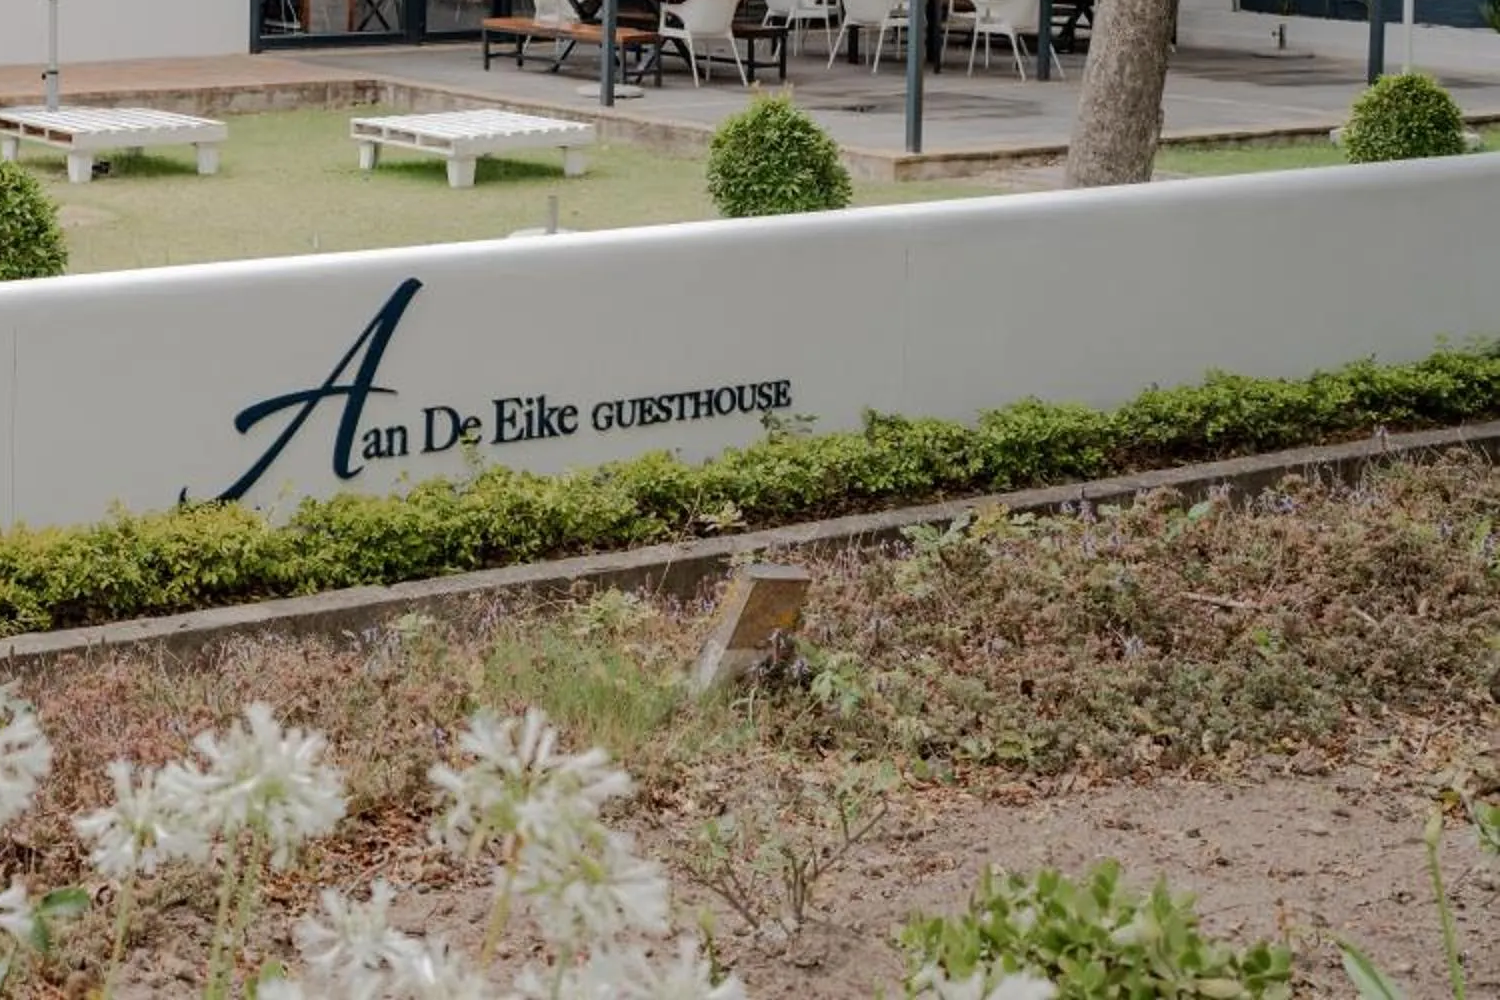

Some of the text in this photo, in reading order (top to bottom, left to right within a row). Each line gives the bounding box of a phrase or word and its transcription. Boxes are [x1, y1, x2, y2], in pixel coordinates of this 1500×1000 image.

[420, 405, 482, 453] De
[490, 395, 579, 444] Eike
[592, 379, 792, 431] GUESTHOUSE
